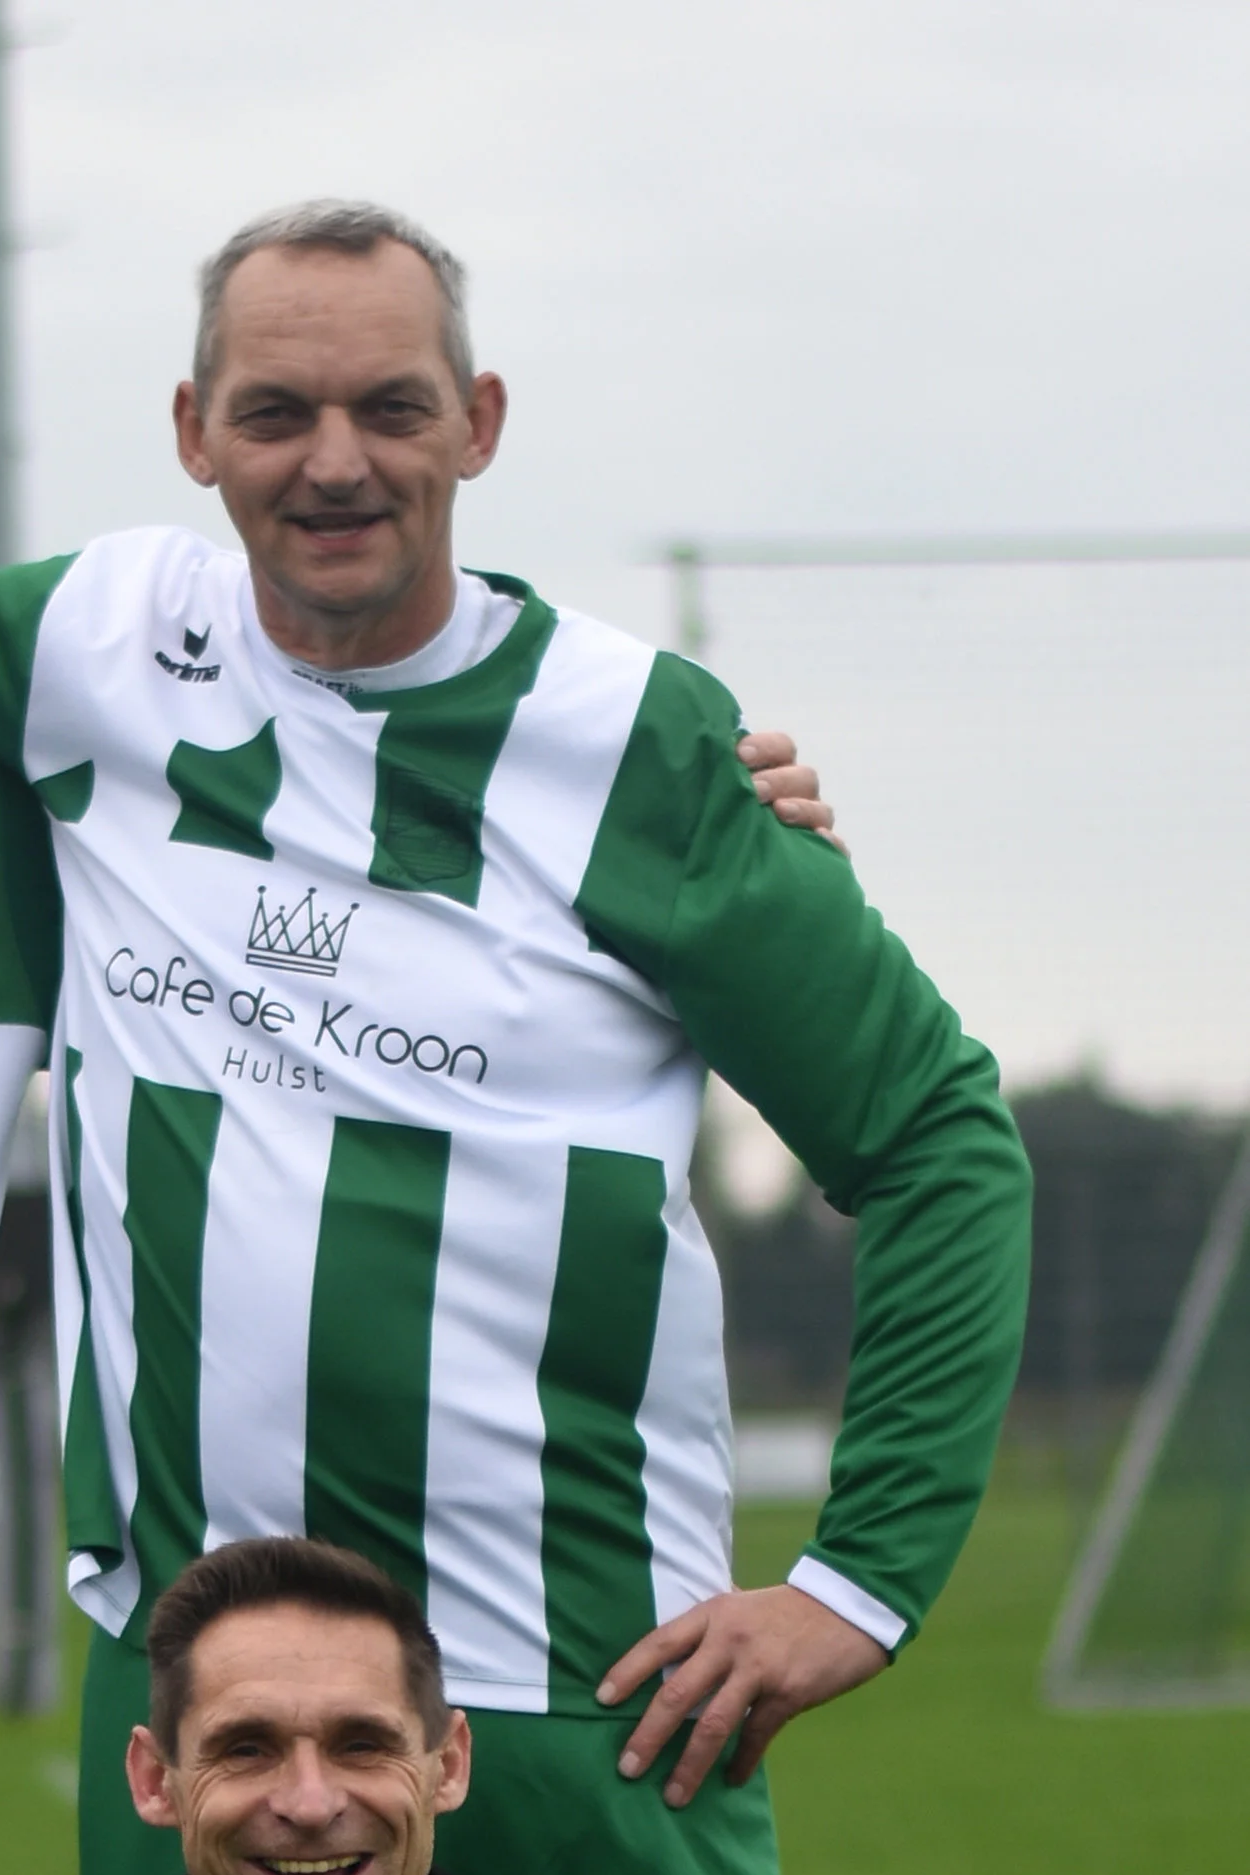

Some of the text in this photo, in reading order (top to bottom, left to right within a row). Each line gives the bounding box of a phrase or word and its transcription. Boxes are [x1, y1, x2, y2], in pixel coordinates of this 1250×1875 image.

[154, 650, 221, 683] erima
[105, 947, 489, 1084] Cafe de Kroon
[222, 1046, 326, 1093] Hulst
